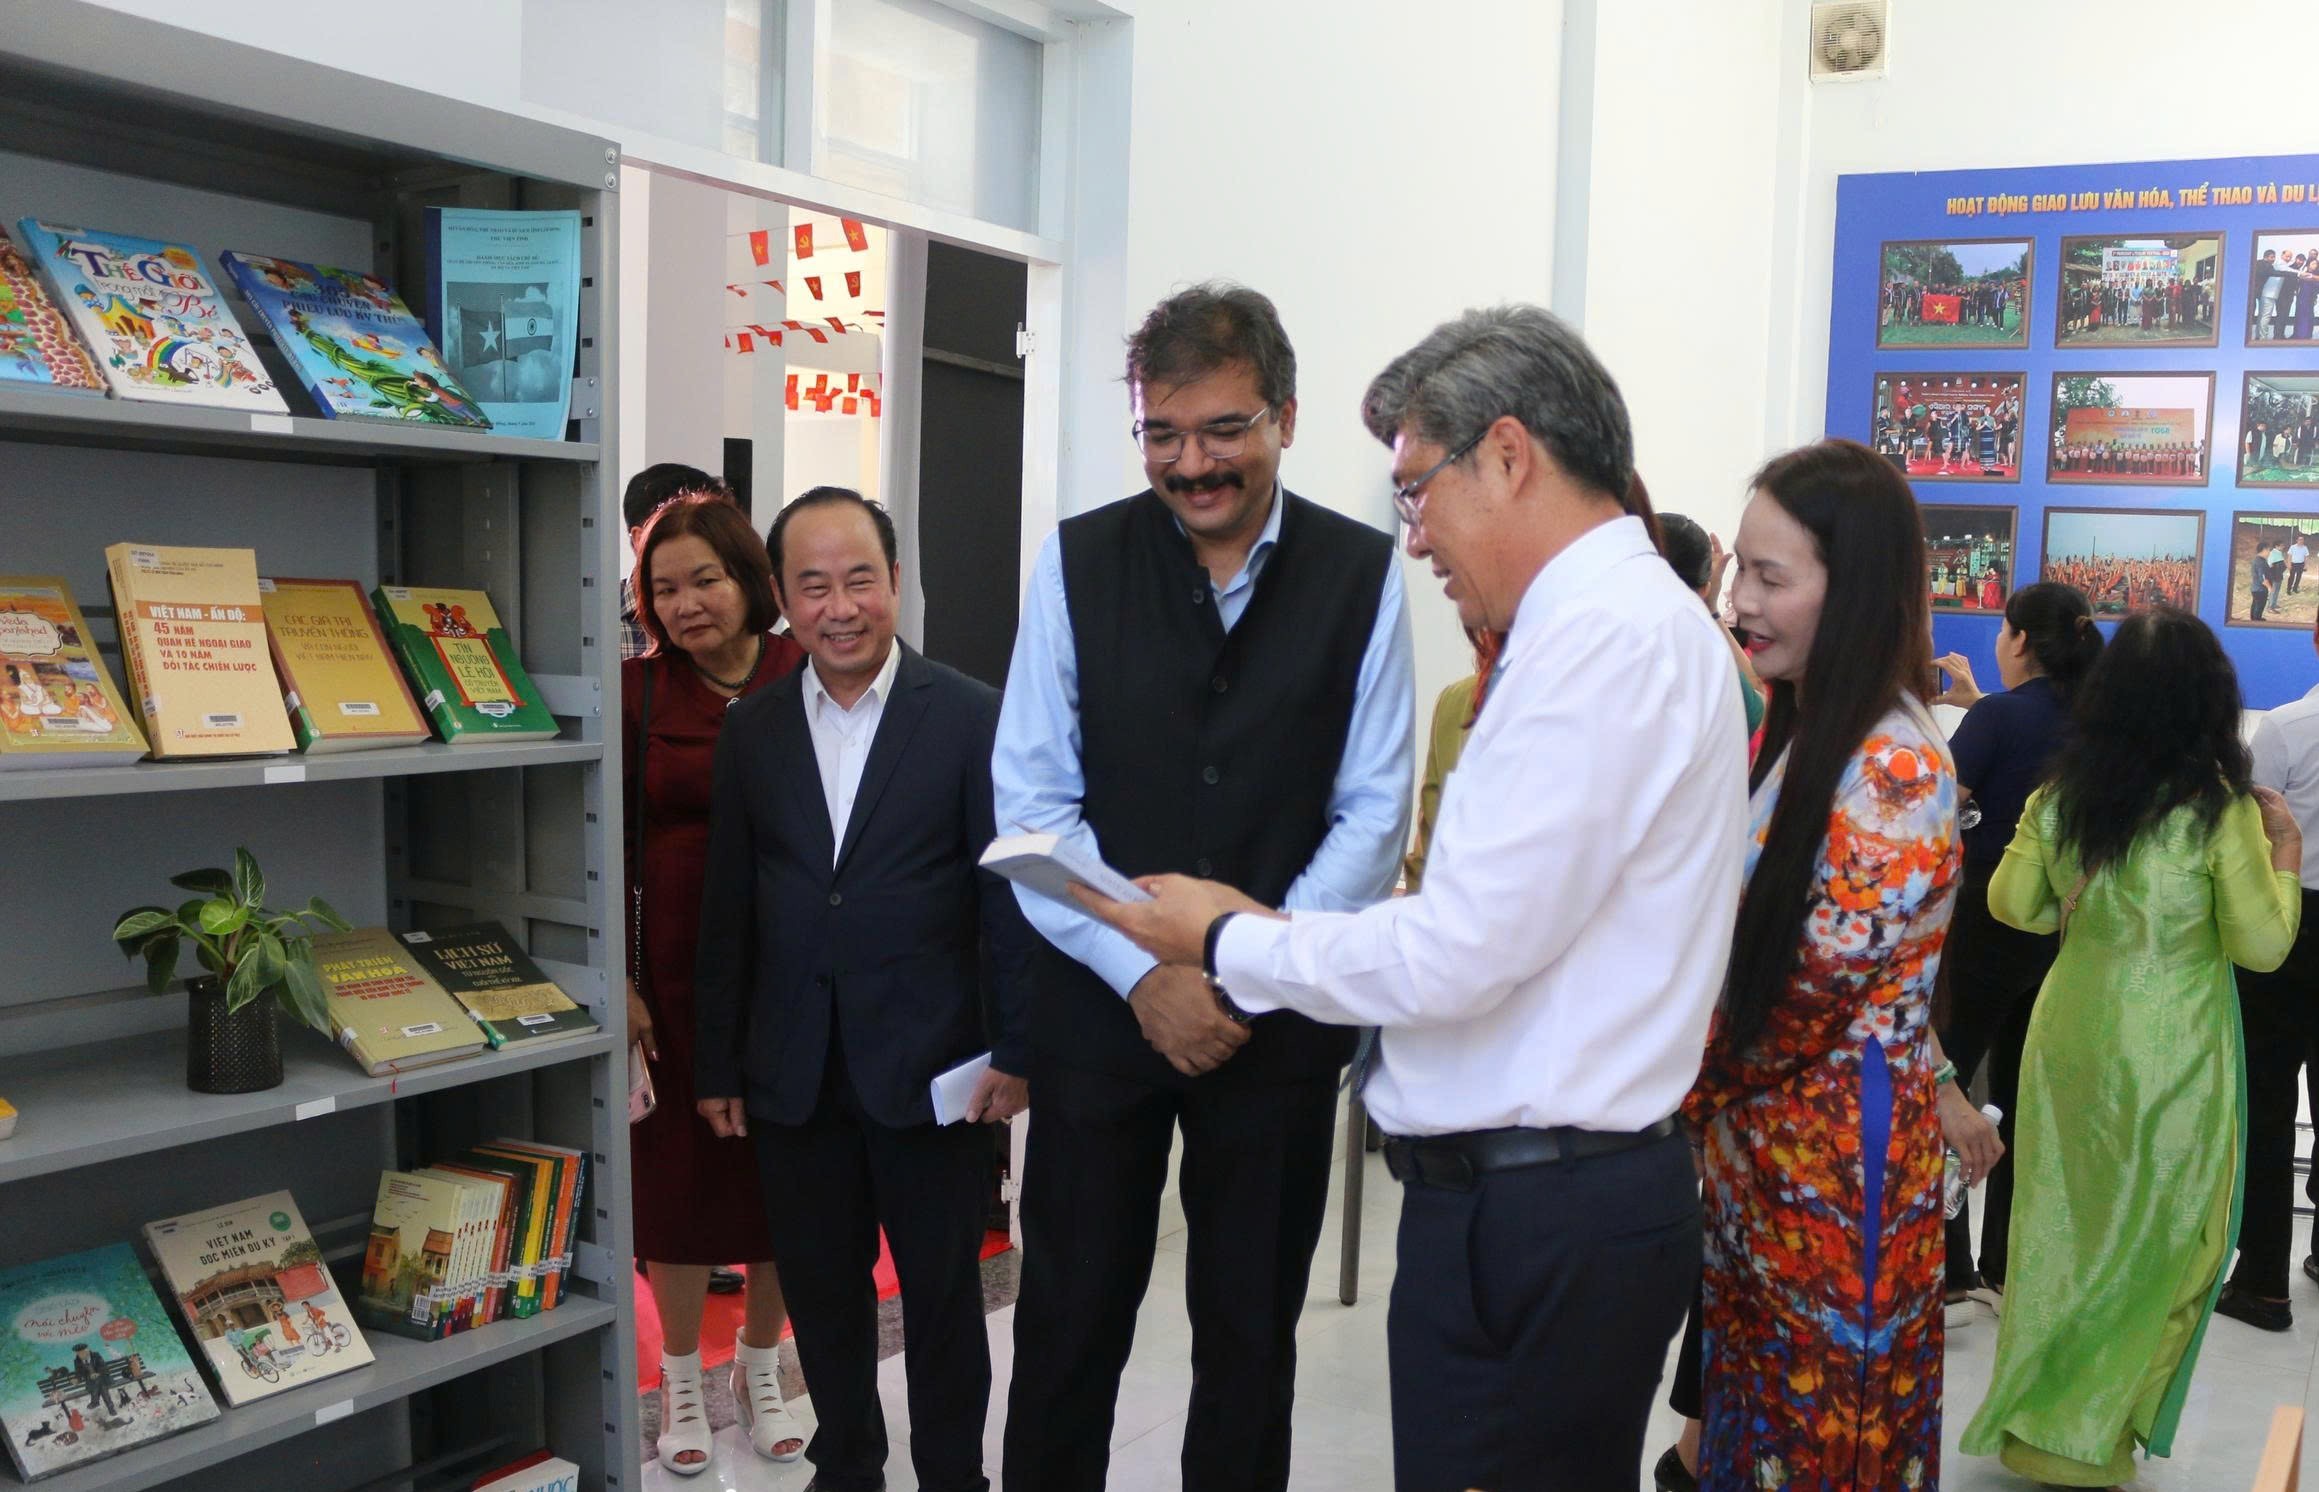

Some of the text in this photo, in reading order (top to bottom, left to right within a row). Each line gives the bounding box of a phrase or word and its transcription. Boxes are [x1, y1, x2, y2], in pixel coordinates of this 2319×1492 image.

[1947, 197, 1984, 217] HOẠT
[1988, 193, 2029, 216] ĐỘNG
[2032, 195, 2067, 212] GIAO
[2071, 191, 2100, 211] LƯU
[2104, 188, 2134, 209] VĂN
[2138, 187, 2175, 209] HÓA,
[2179, 181, 2210, 207] THỂ
[2212, 187, 2252, 206] THAO
[2257, 182, 2278, 203] VÀ
[2282, 184, 2305, 202] DU
[149, 604, 175, 623] VIỆT
[176, 606, 202, 620] NAM
[154, 622, 170, 635] 45
[176, 650, 188, 659] 10
[231, 1229, 254, 1243] NAM
